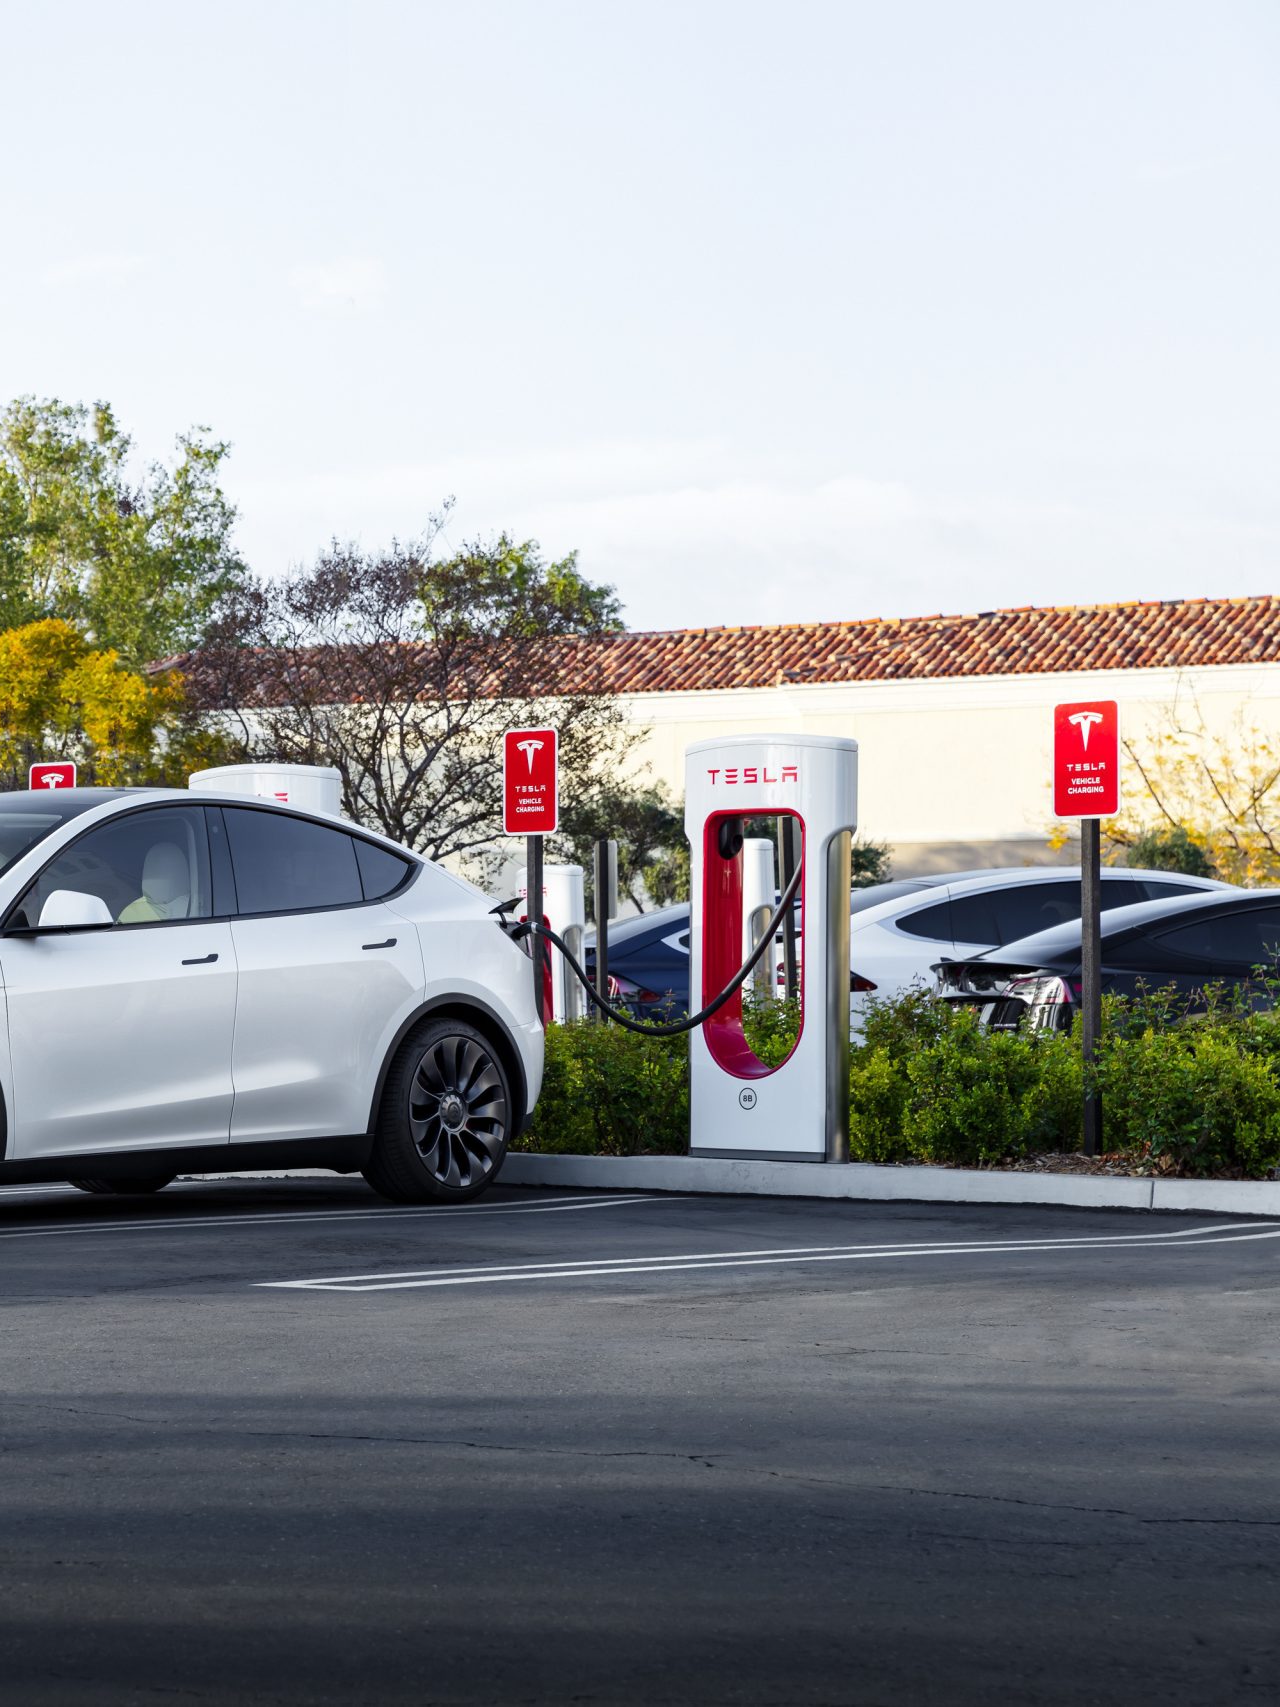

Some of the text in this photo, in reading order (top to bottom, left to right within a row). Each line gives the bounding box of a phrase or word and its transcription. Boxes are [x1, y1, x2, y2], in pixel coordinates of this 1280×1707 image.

[1066, 762, 1106, 772] TESLA
[707, 766, 798, 785] TESLA
[1071, 777, 1101, 785] VEHICLE
[515, 785, 546, 793] TESLA
[1067, 786, 1104, 795] CHARGING
[515, 805, 545, 813] CHARGING
[742, 1094, 753, 1102] 8B
